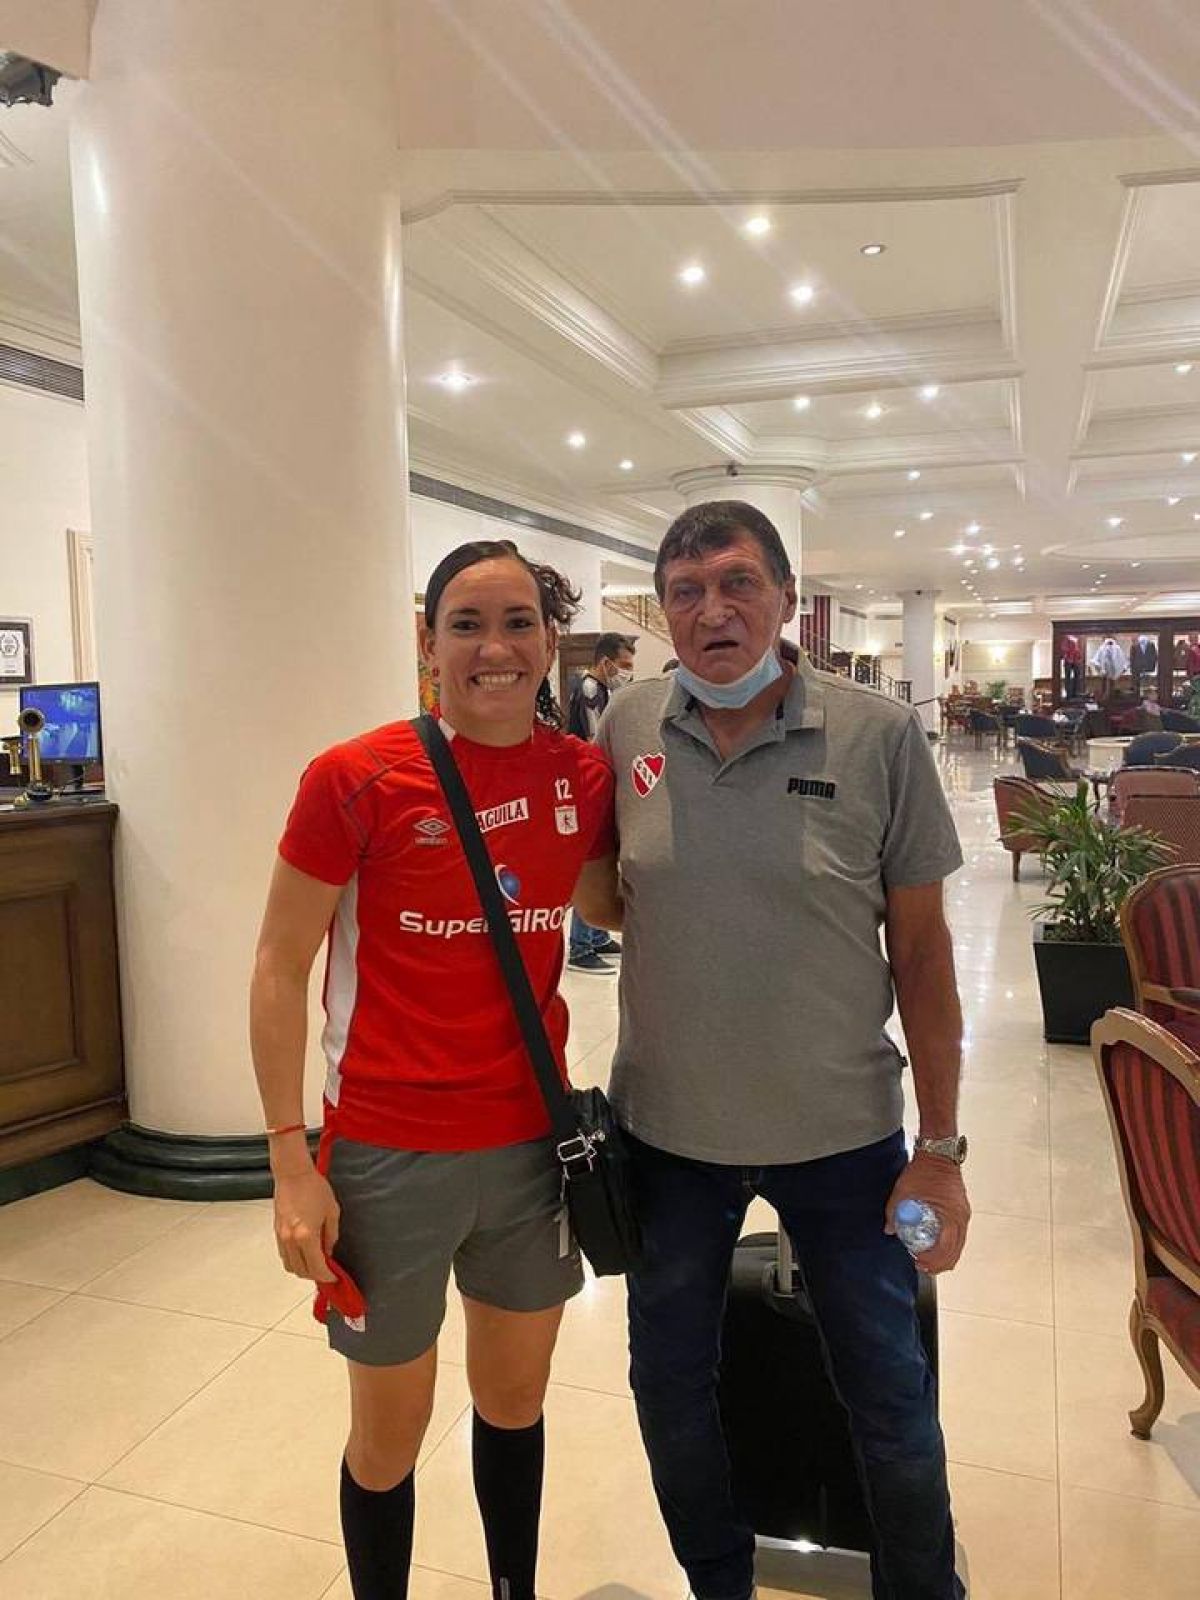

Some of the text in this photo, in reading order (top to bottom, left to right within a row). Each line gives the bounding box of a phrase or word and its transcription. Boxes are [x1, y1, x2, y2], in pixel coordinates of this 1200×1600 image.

[555, 778, 573, 800] 12
[787, 777, 836, 800] PUMA
[399, 903, 568, 938] SupeGIRO
